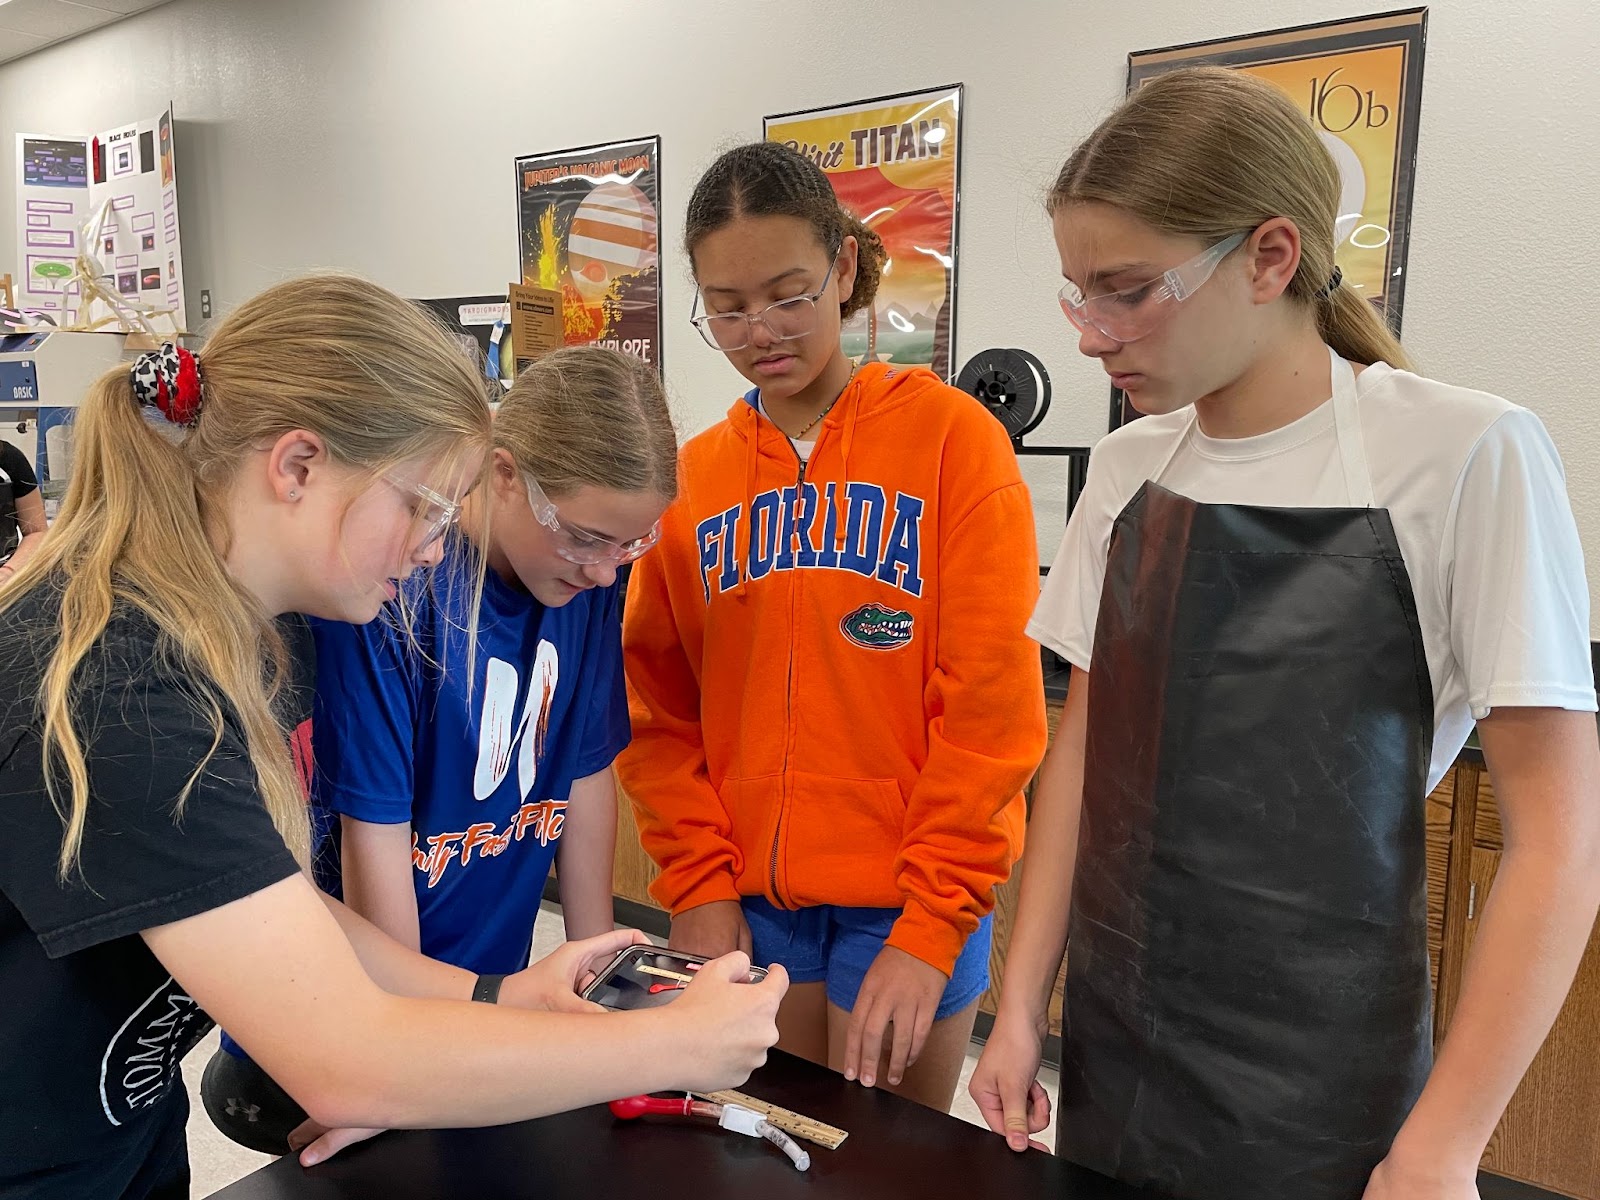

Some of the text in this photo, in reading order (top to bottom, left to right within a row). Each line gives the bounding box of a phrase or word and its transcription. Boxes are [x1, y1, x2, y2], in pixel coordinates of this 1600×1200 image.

[851, 117, 940, 166] TITAN
[619, 154, 650, 175] MOON
[13, 386, 33, 399] BASIC
[696, 482, 924, 606] FLORIDA
